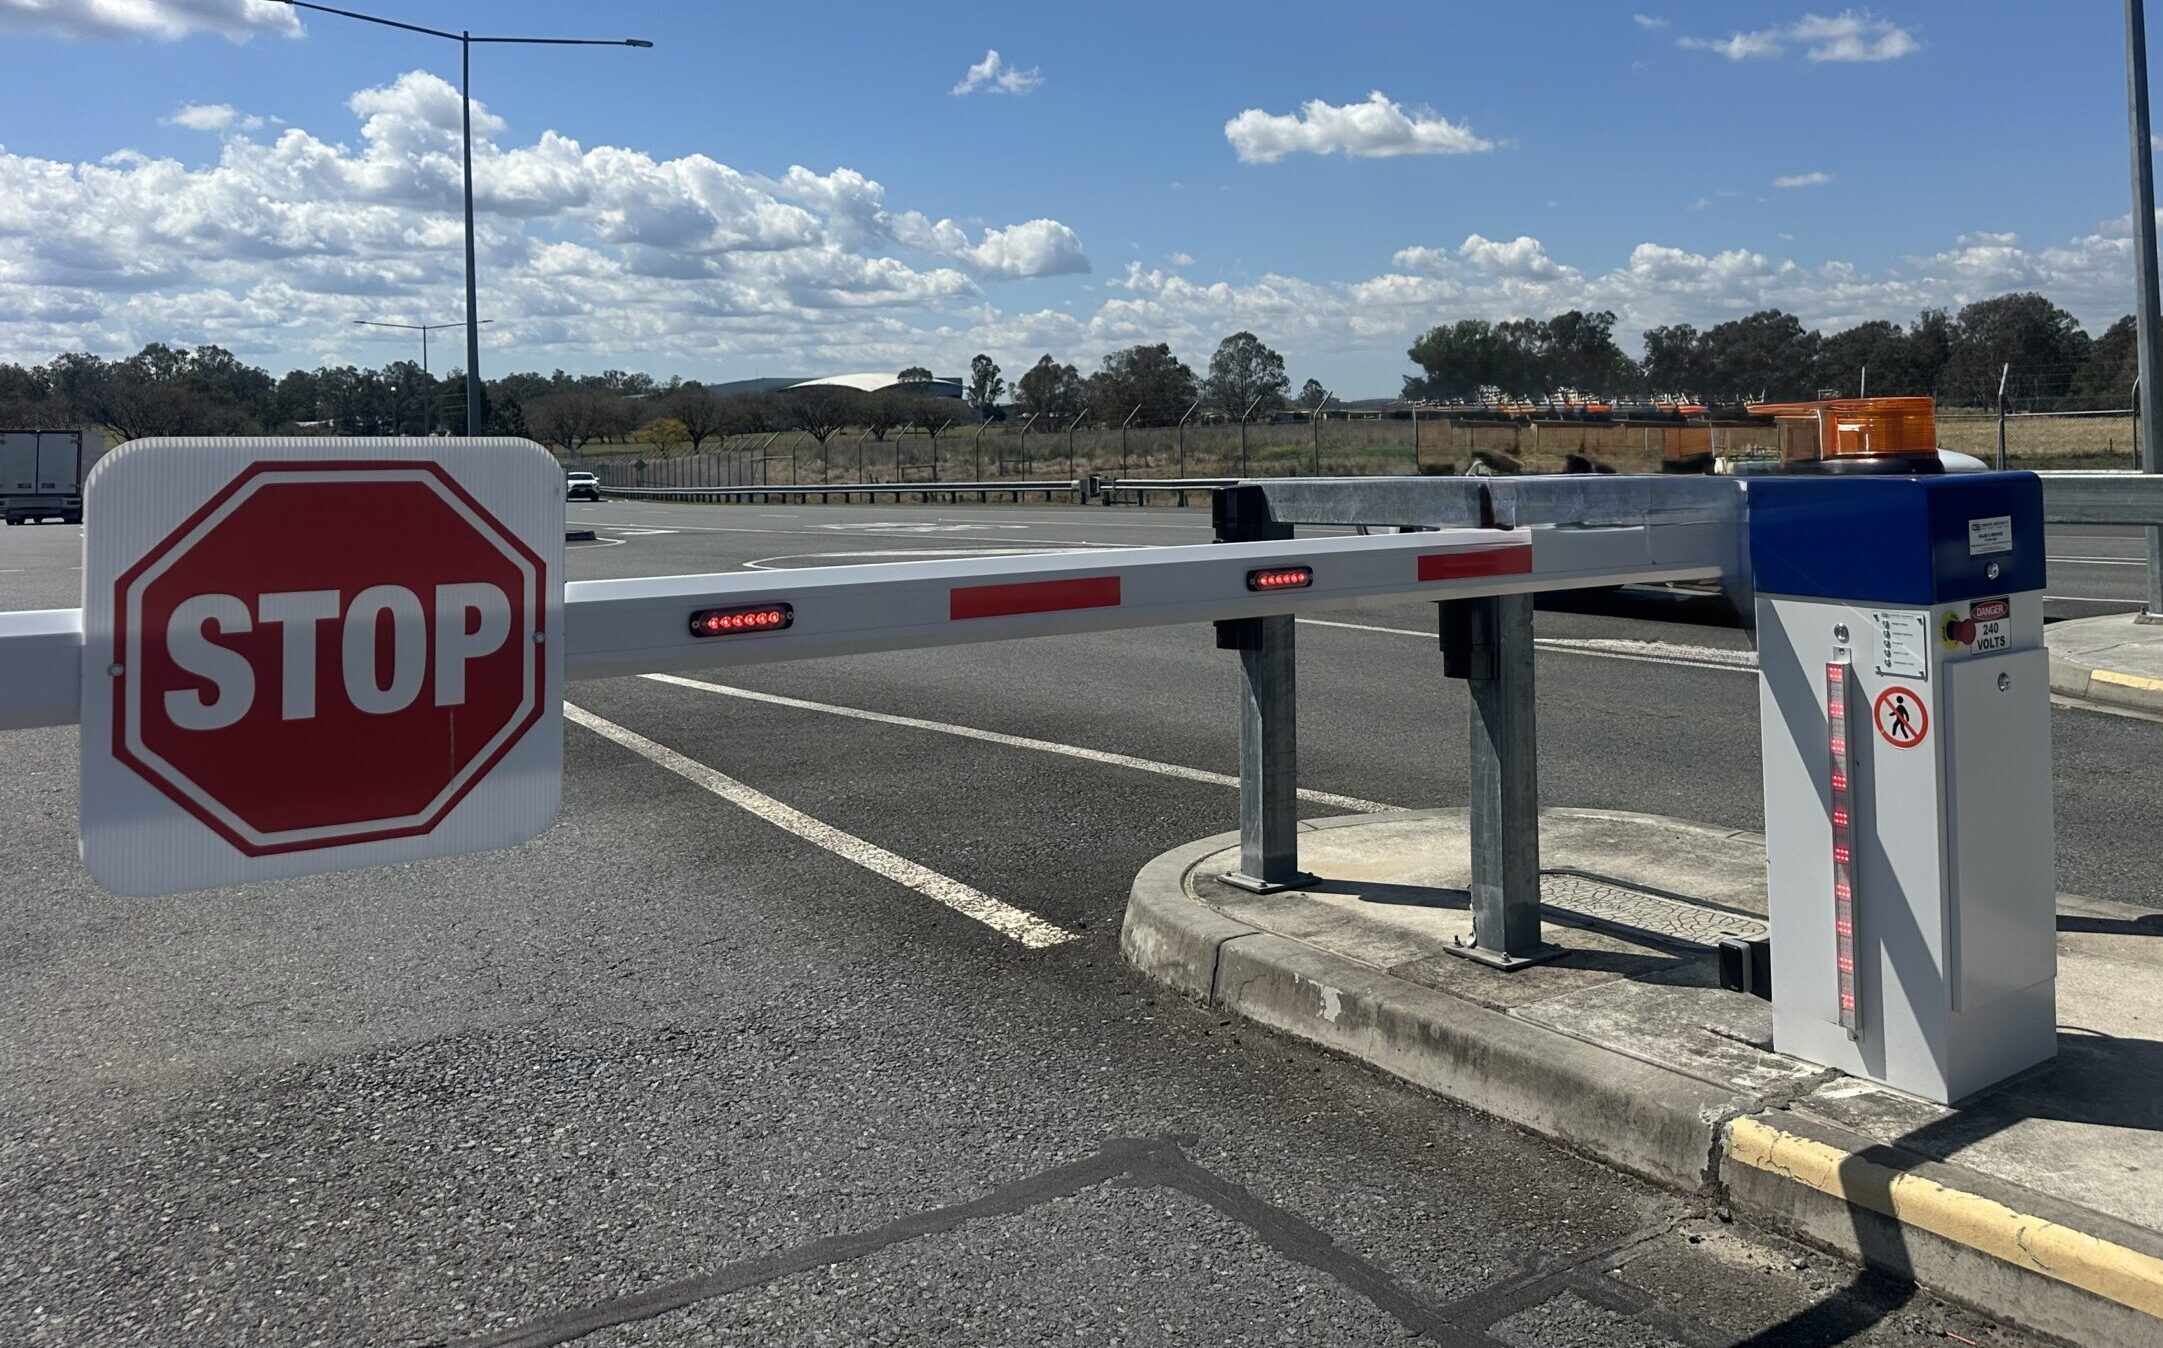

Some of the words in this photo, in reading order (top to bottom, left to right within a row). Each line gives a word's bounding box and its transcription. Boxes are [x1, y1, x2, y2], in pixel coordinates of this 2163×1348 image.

[1976, 604, 2004, 617] DANGER
[1983, 622, 1999, 635] 240
[1977, 636, 2006, 650] VOLTS
[163, 582, 512, 731] STOP
